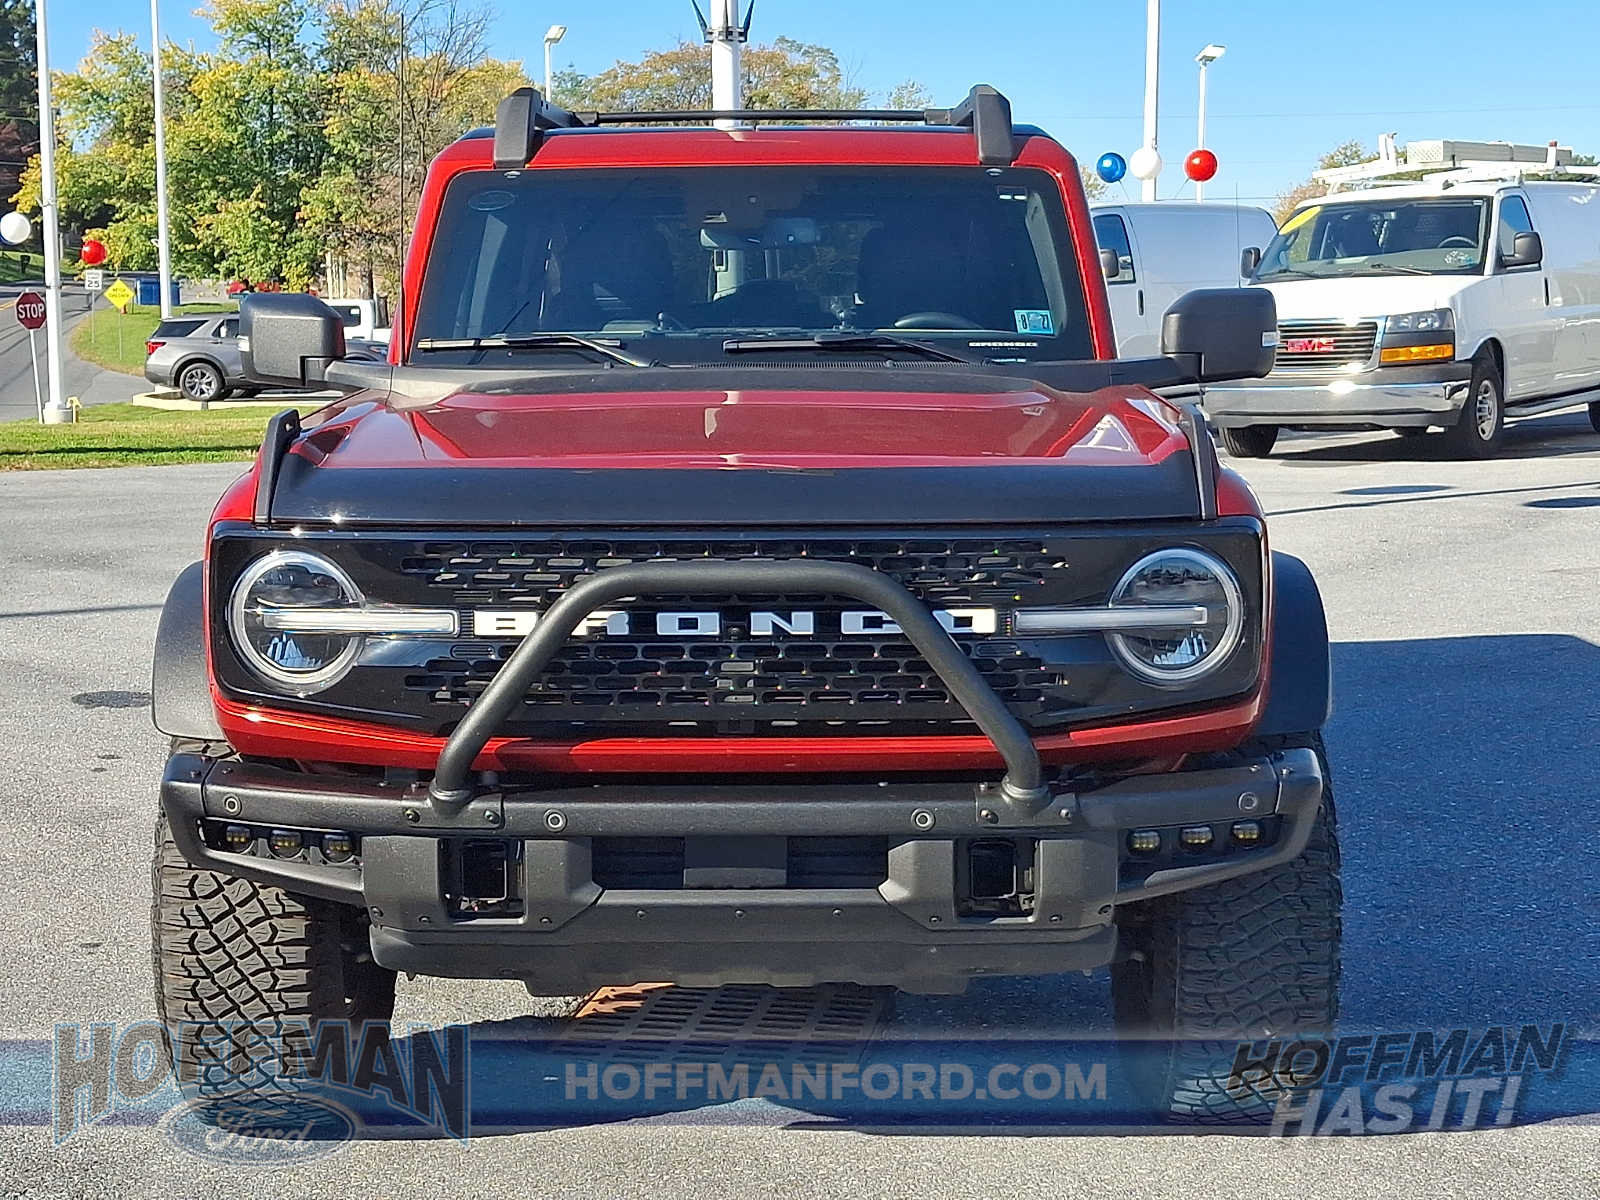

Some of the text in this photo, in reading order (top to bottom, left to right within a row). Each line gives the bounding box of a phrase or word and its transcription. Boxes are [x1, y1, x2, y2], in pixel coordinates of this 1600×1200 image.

[87, 280, 100, 288] 25
[17, 303, 45, 319] STOP
[473, 609, 996, 635] BRONCO
